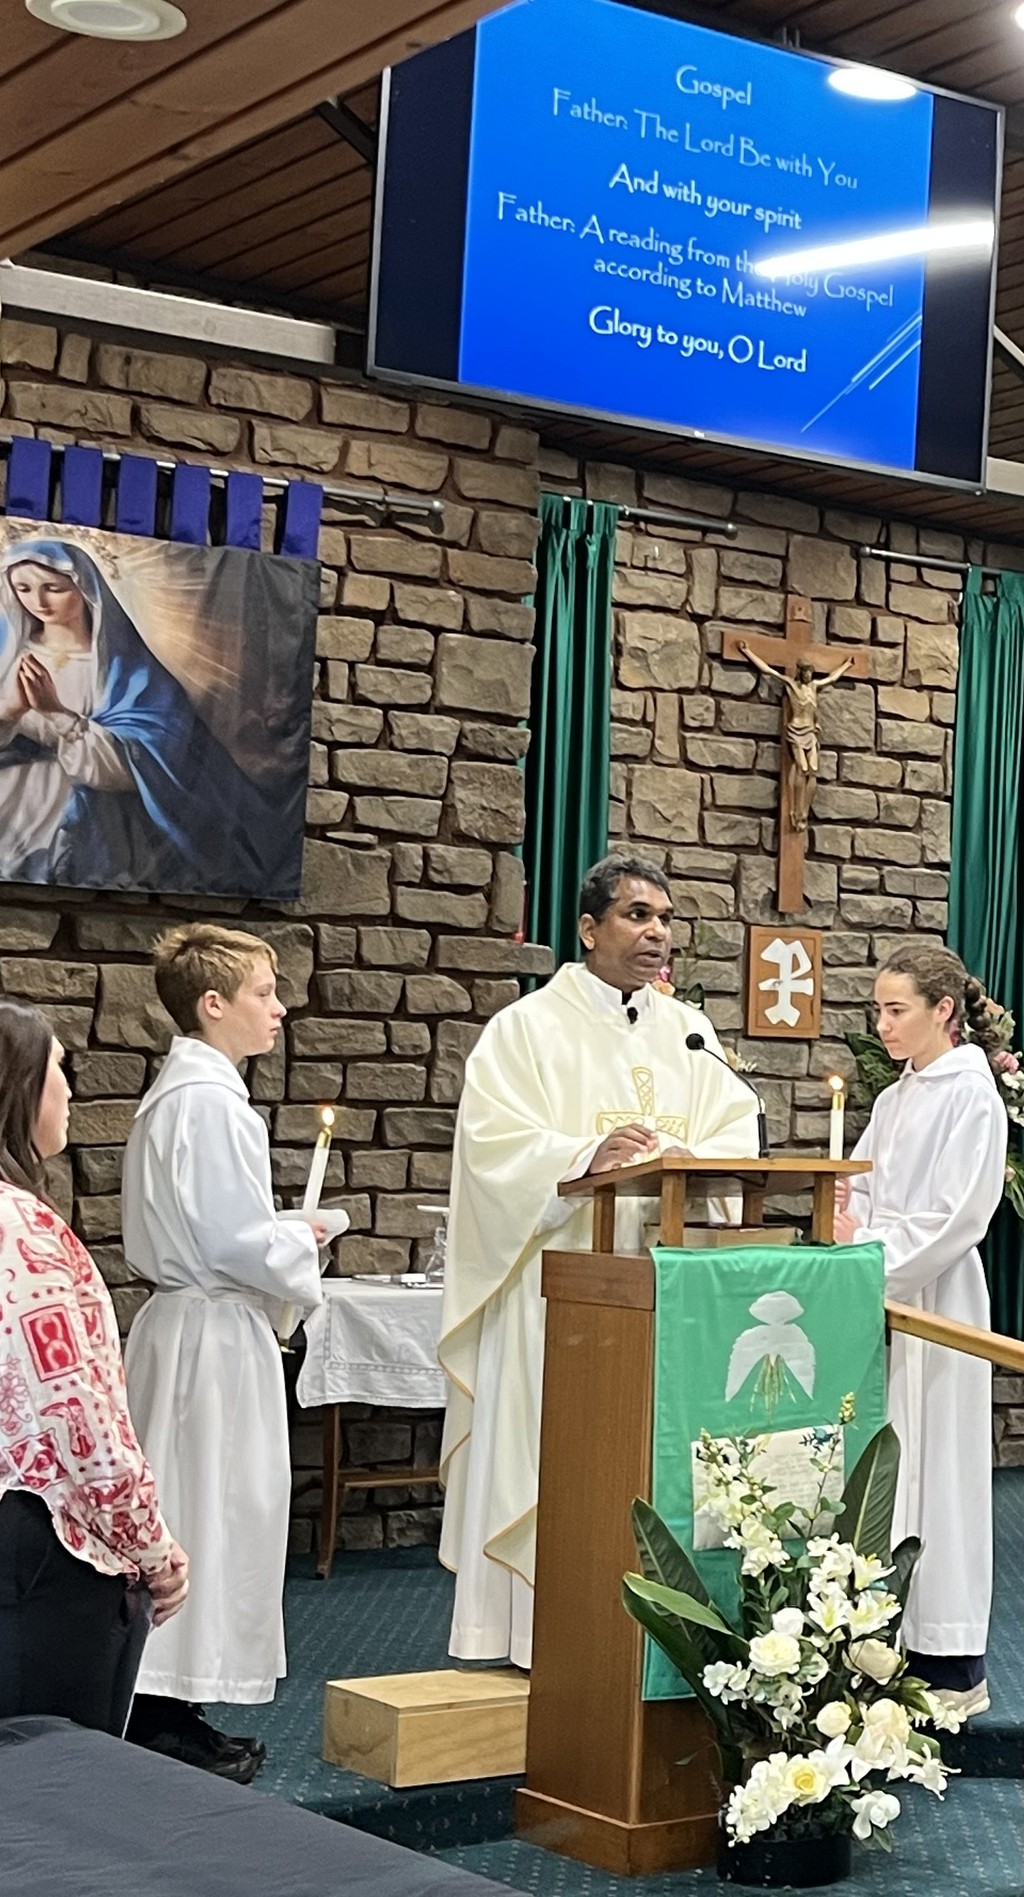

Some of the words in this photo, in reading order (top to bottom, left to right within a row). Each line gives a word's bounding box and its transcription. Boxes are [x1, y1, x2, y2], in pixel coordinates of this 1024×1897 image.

[675, 64, 752, 110] Gospel
[552, 87, 629, 130] Father:
[633, 108, 679, 143] The
[684, 122, 735, 157] Lord
[738, 135, 772, 167] Be
[774, 152, 812, 178] with
[816, 156, 858, 190] You
[608, 162, 659, 194] And
[662, 179, 702, 206] with
[704, 194, 752, 218] your
[754, 206, 803, 233] spirit
[497, 190, 576, 233] Father:
[578, 213, 605, 244] A
[608, 226, 683, 265] reading
[687, 235, 730, 269] from
[735, 249, 768, 277] th
[822, 271, 894, 312] Gospel
[593, 260, 693, 299] according
[695, 277, 717, 297] to
[721, 276, 808, 317] Matthew
[588, 304, 653, 348] Glory
[656, 324, 679, 345] to
[680, 334, 725, 358] you,
[727, 333, 754, 364] O
[757, 339, 807, 373] Lord
